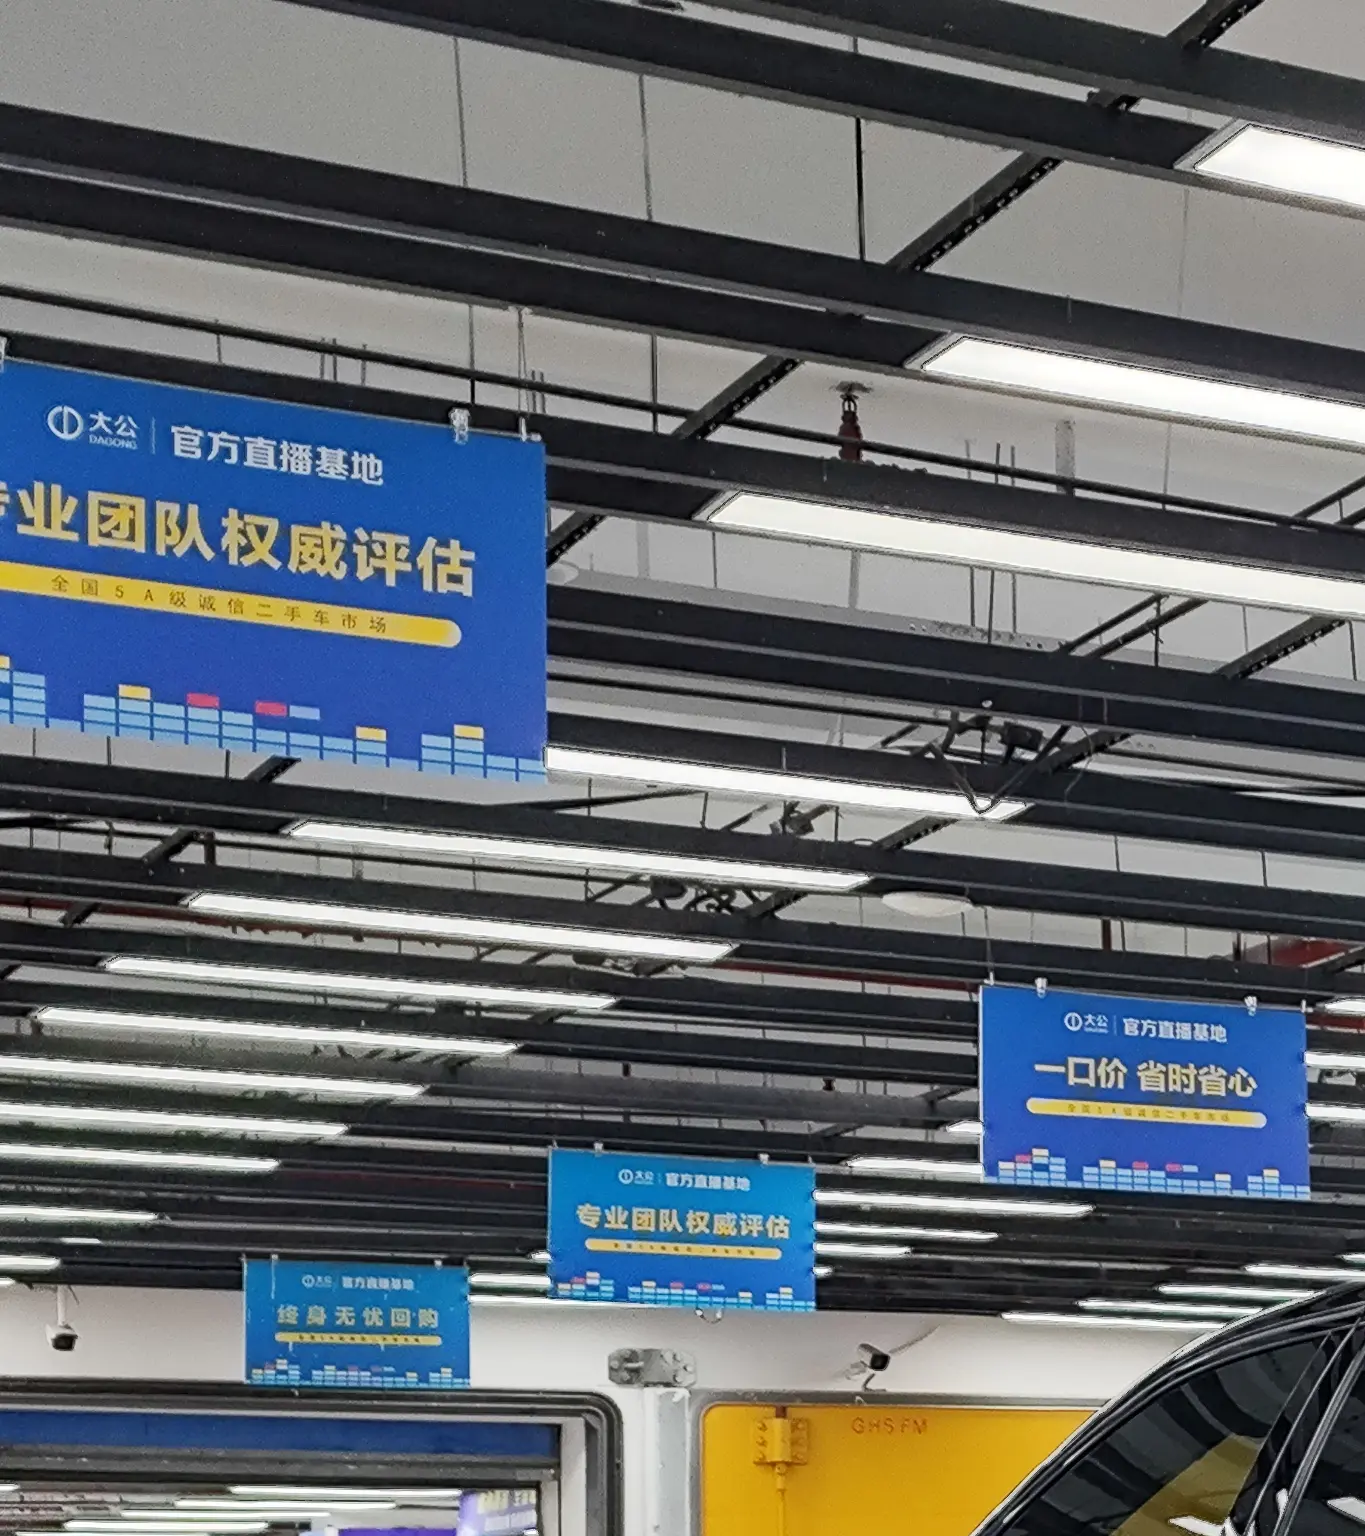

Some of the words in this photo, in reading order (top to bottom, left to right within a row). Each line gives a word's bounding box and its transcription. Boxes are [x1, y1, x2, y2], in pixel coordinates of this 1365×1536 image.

[89, 411, 140, 438] 大公
[171, 425, 384, 486] 官方直播基地
[0, 481, 476, 597] 业团队权威评估
[1122, 1018, 1228, 1043] 官方直播基地
[1034, 1056, 1128, 1090] 一口价
[1137, 1060, 1258, 1098] 省时省心
[576, 1203, 790, 1239] 专业团队权威评估
[276, 1304, 439, 1328] 终身无忧回购
